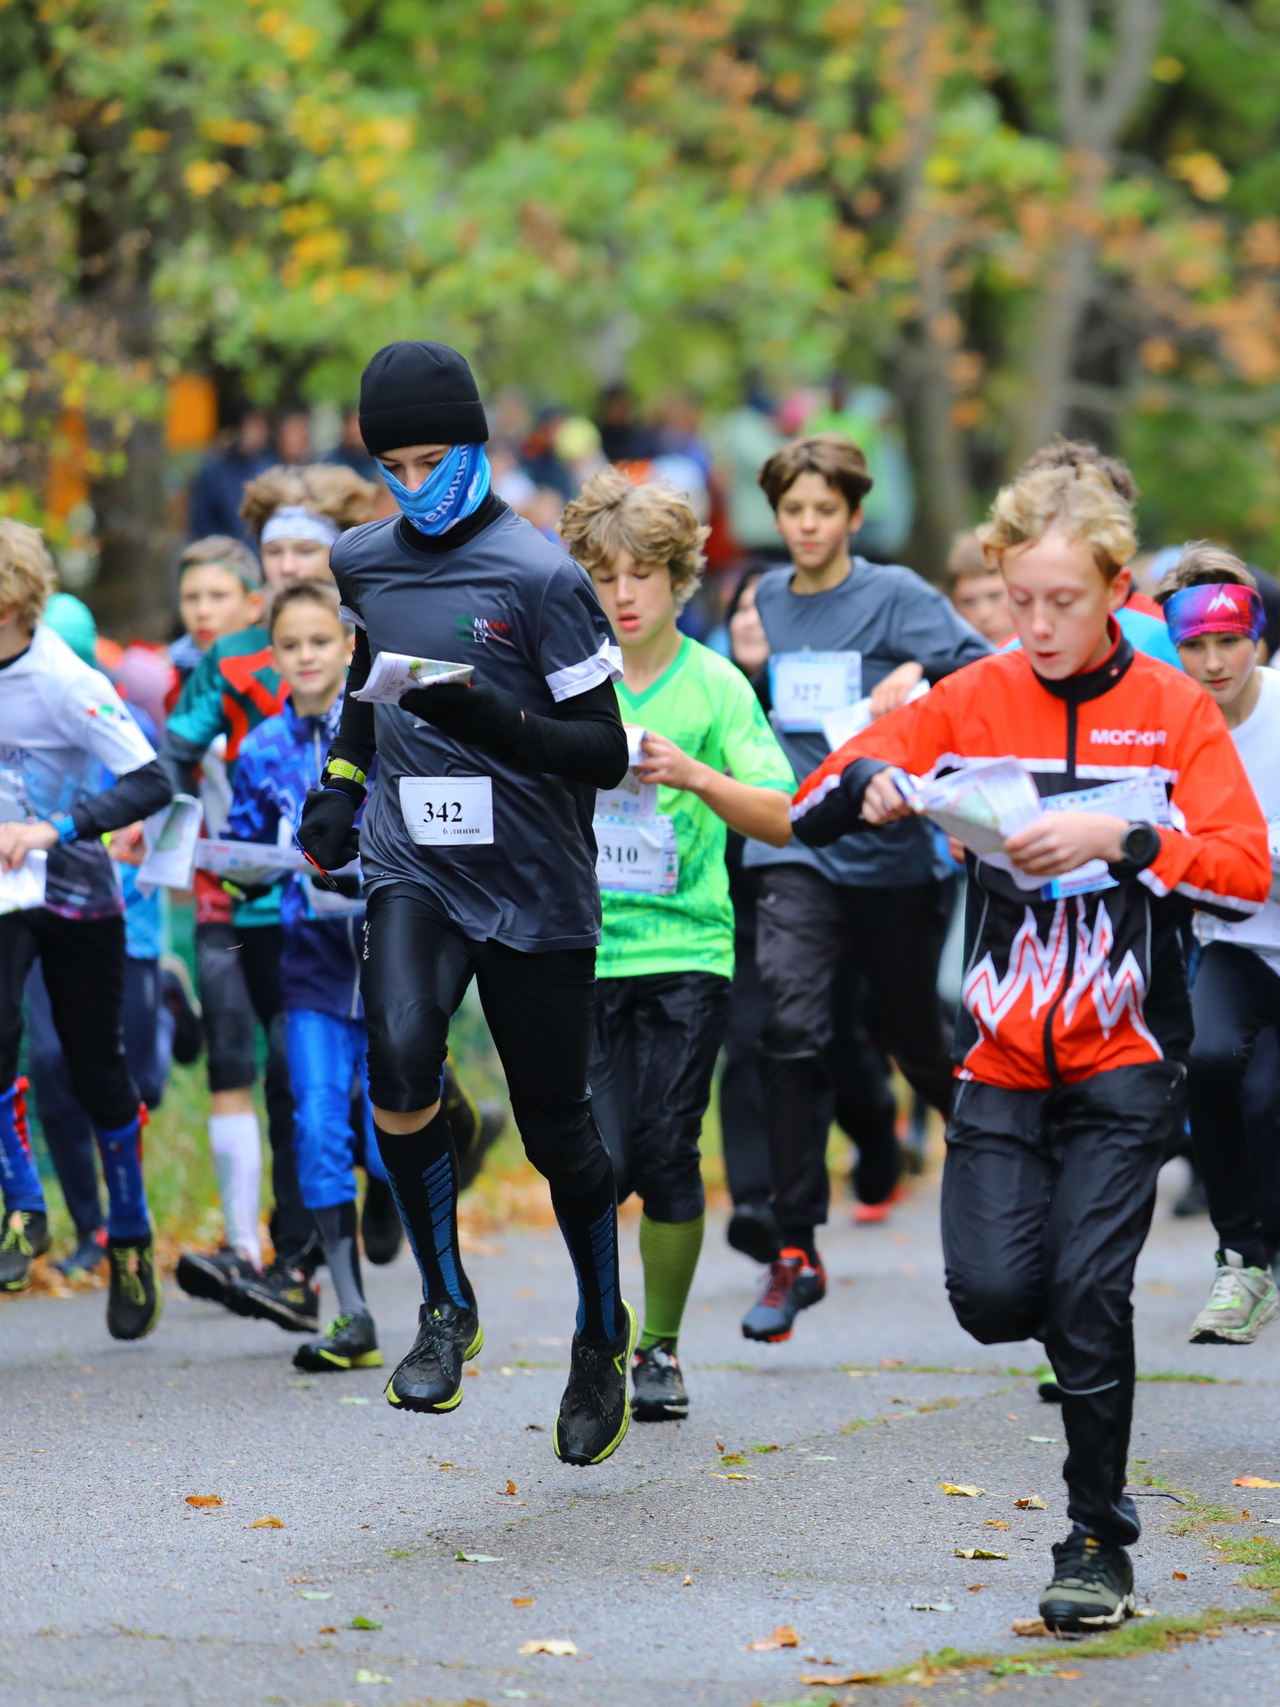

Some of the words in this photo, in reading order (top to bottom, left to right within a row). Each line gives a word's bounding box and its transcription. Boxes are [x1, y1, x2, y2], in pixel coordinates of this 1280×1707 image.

[791, 682, 821, 701] 327
[423, 801, 463, 823] 342
[443, 827, 448, 835] 6
[450, 827, 480, 835] линия
[601, 844, 638, 864] 310
